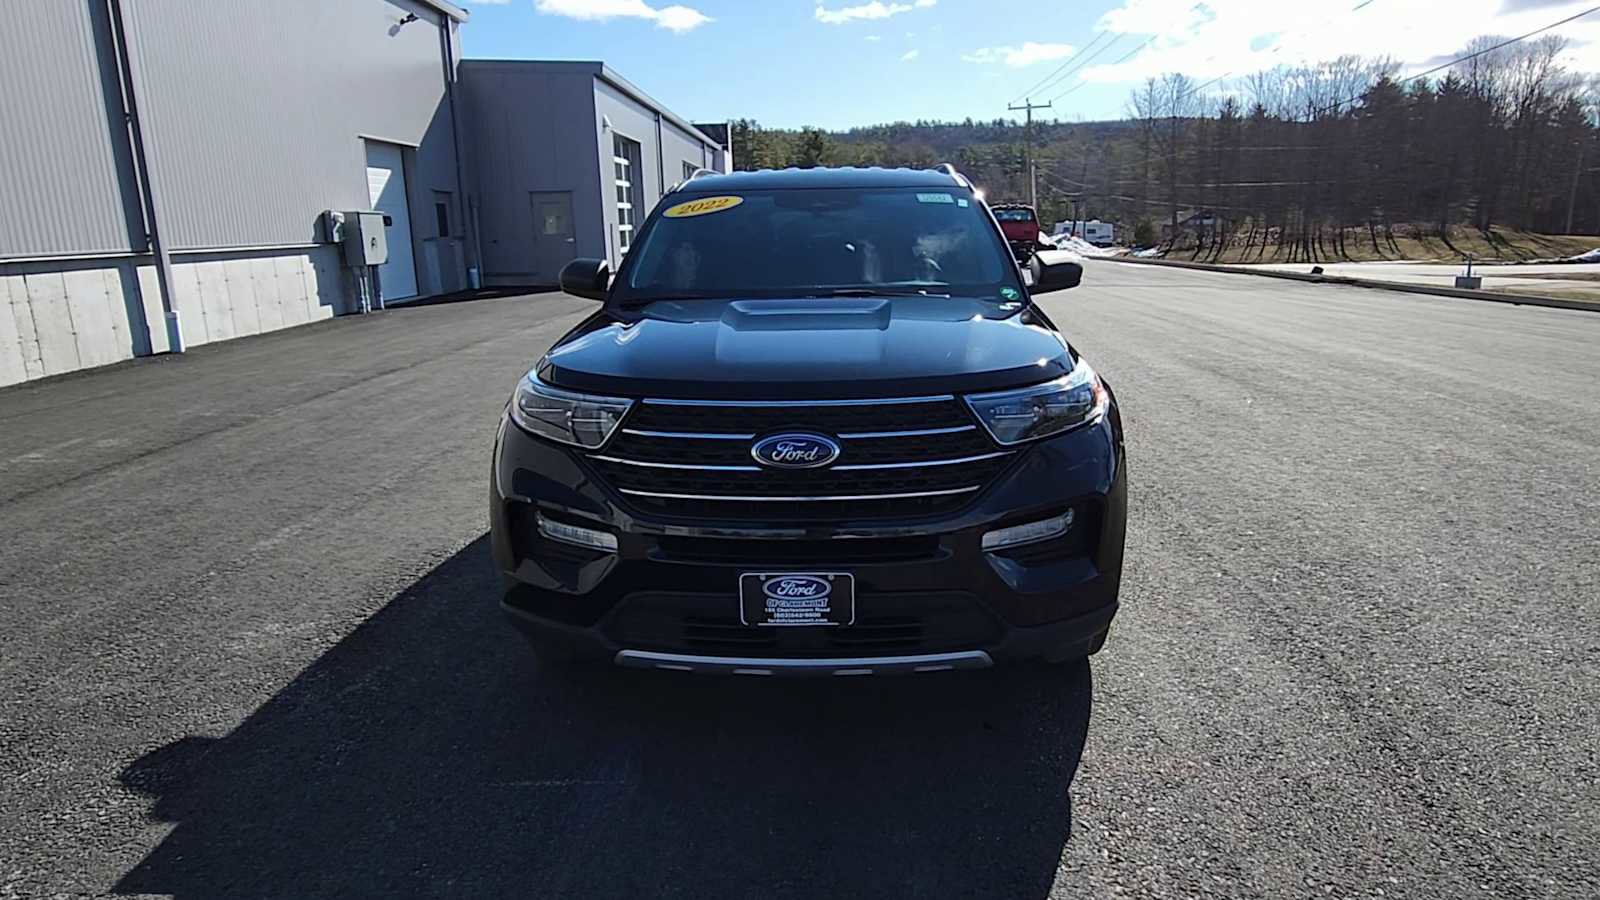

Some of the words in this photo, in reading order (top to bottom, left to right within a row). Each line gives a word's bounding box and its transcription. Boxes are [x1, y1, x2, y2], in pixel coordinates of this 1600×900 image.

[678, 198, 729, 215] 2022
[771, 440, 819, 461] Ford
[776, 579, 817, 596] Ford
[766, 598, 777, 607] OF
[777, 598, 828, 607] CLAREMONT
